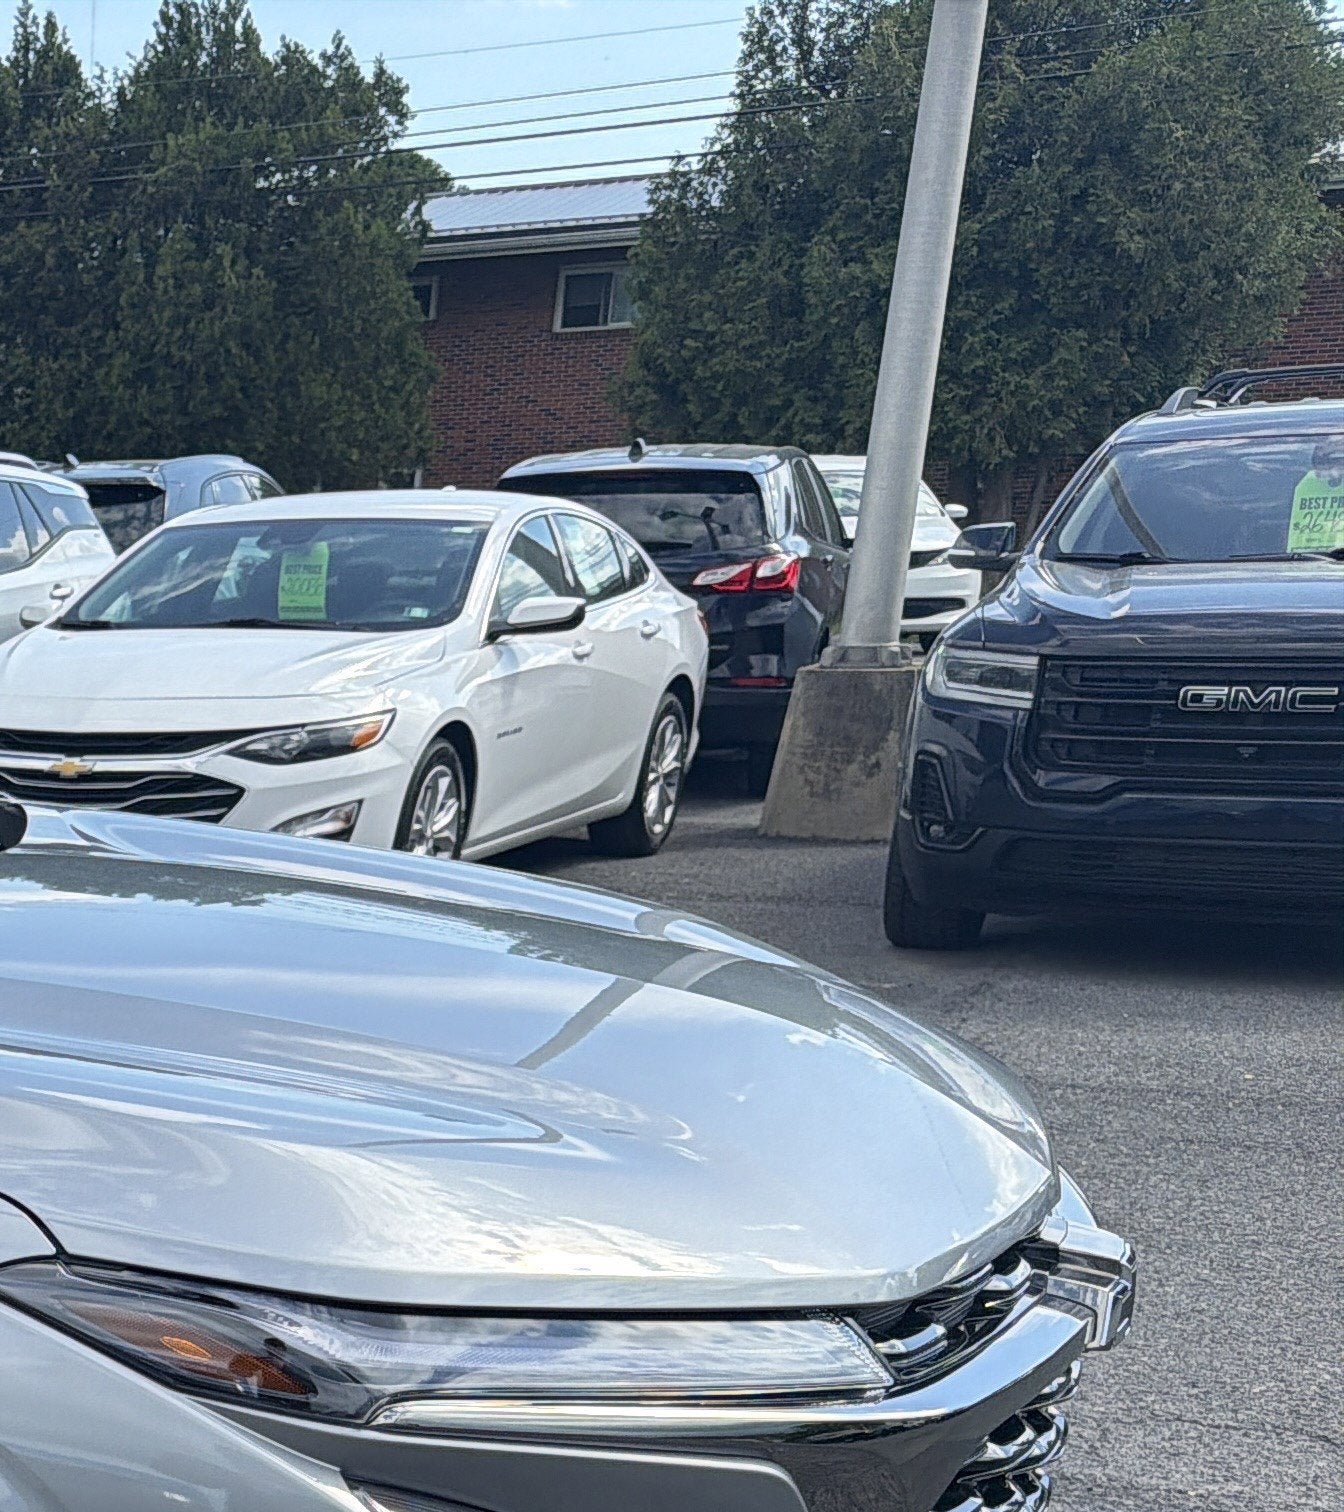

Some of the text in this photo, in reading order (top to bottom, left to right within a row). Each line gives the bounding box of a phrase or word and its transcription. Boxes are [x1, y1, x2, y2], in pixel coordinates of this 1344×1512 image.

[1299, 496, 1328, 510] BEST
[285, 564, 300, 575] BEST
[1177, 686, 1339, 712] GMC
